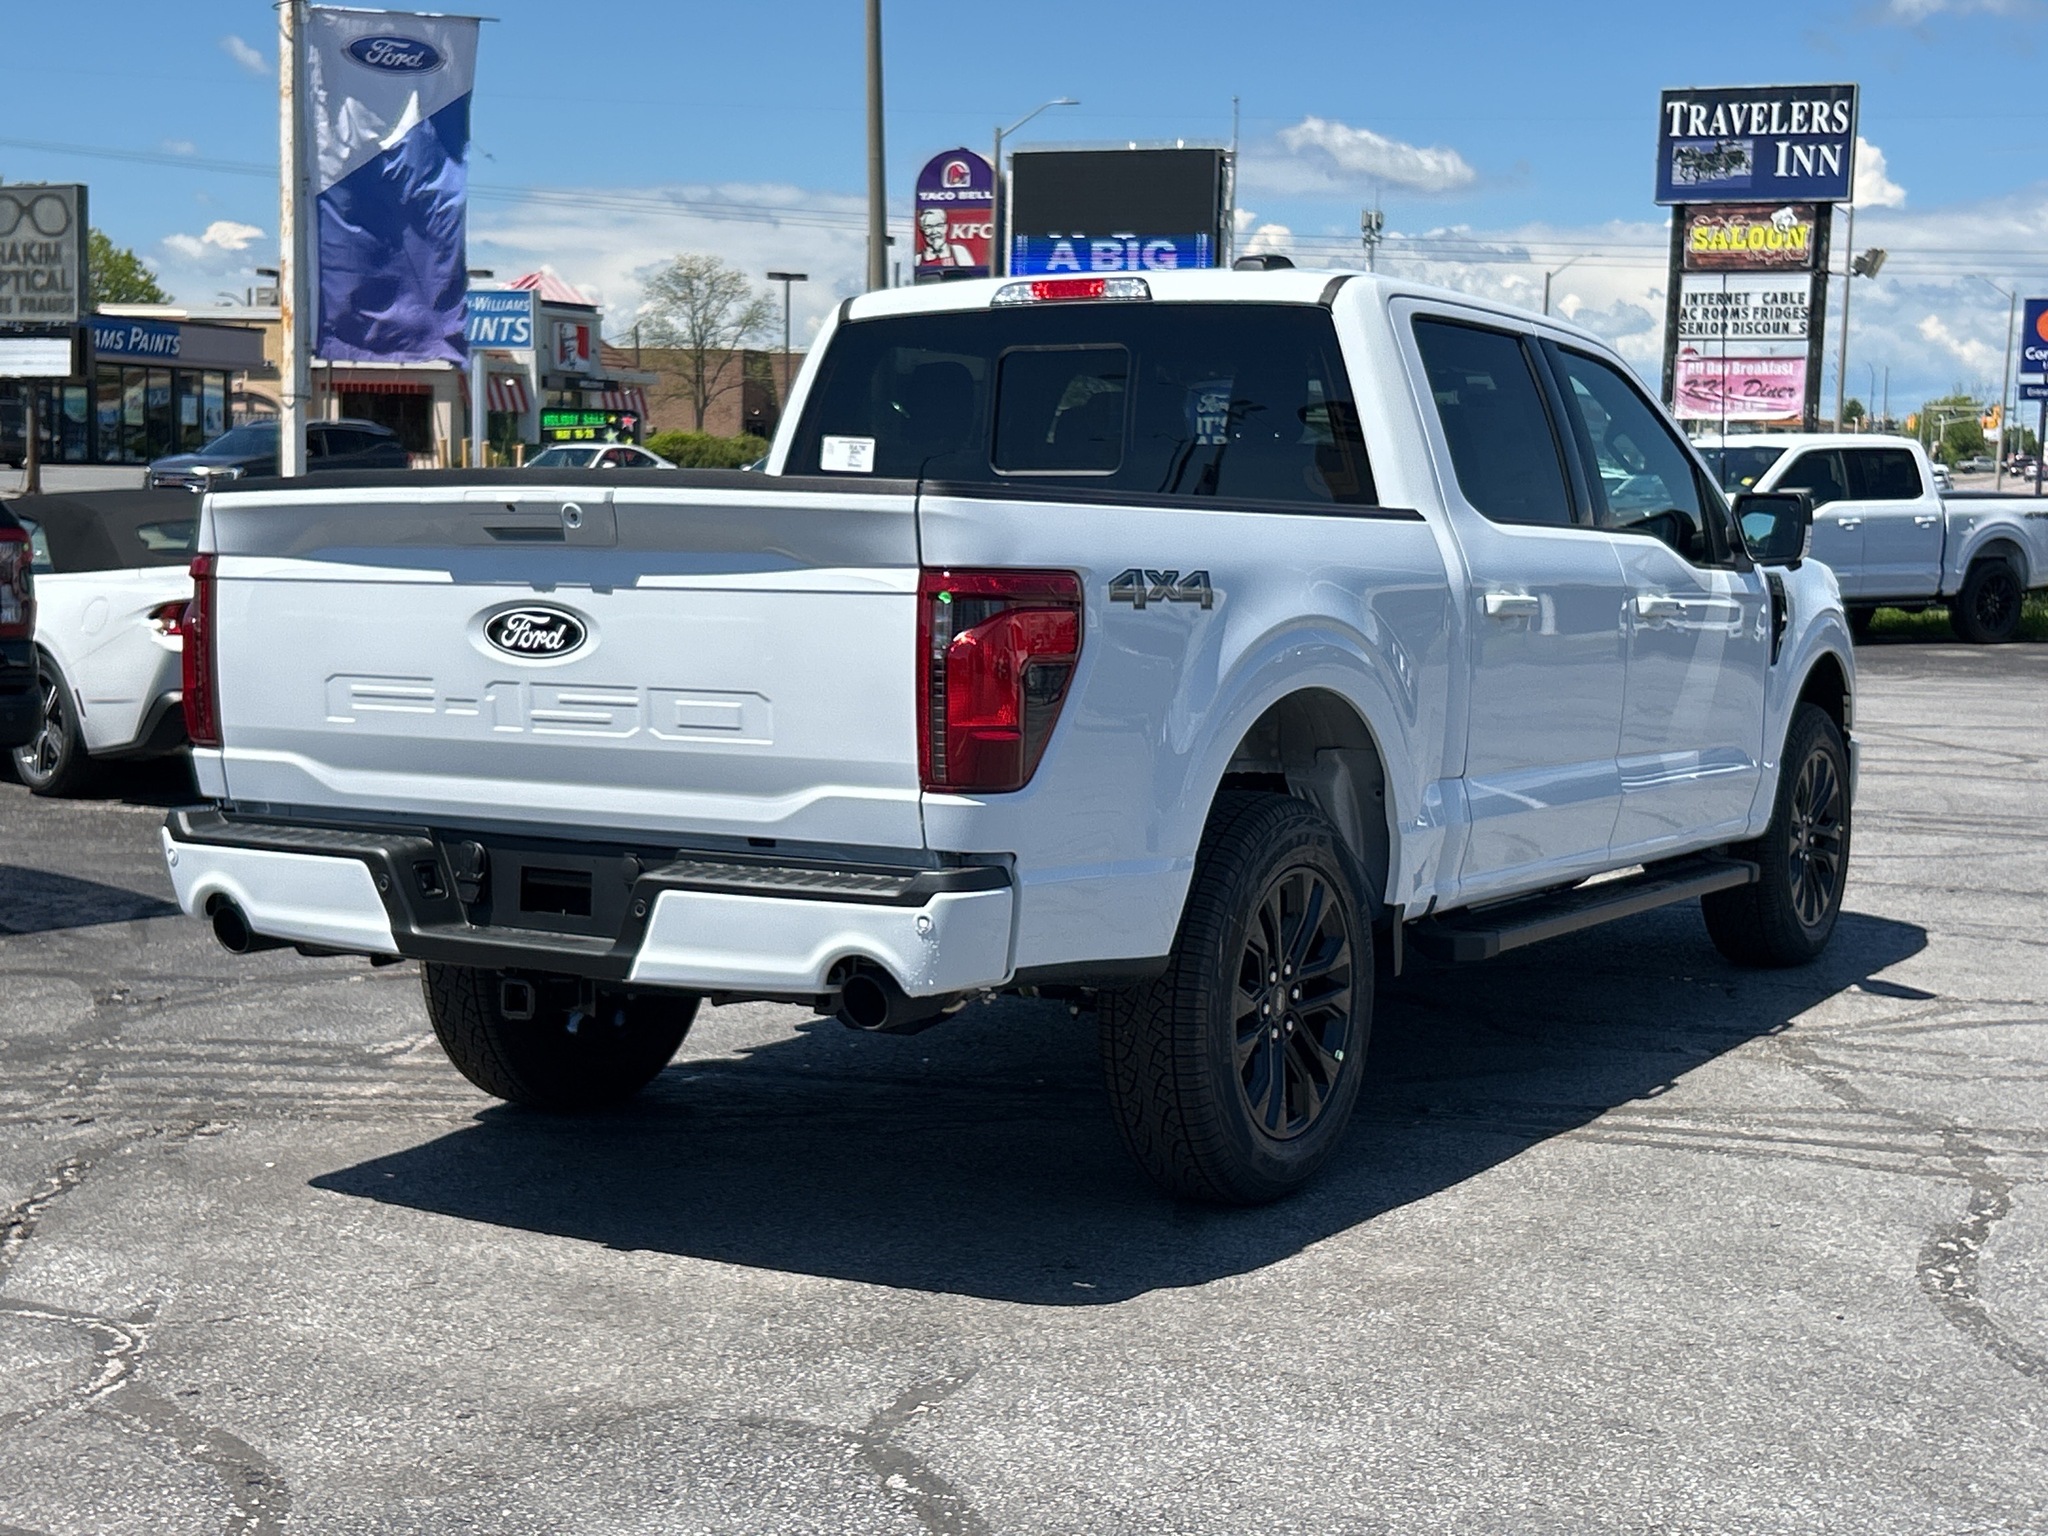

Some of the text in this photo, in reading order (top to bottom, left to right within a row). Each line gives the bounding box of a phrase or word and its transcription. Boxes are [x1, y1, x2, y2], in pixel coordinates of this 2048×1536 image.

[365, 39, 424, 67] Ford
[1666, 100, 1850, 137] TRAVELERS
[1773, 141, 1843, 178] INN
[919, 191, 994, 200] TACO BELL
[949, 223, 994, 240] KFC
[1691, 224, 1808, 252] SALOON
[1046, 240, 1178, 271] A BIG
[1685, 292, 1806, 306] INTERNET CABLE
[1680, 307, 1809, 320] AC ROOMS FRIDGES
[128, 326, 181, 355] PAINTS
[470, 316, 531, 343] INTS
[1732, 361, 1794, 376] Breakfast
[1743, 378, 1797, 399] Diner
[501, 613, 567, 649] Ford
[324, 673, 773, 745] F-150
